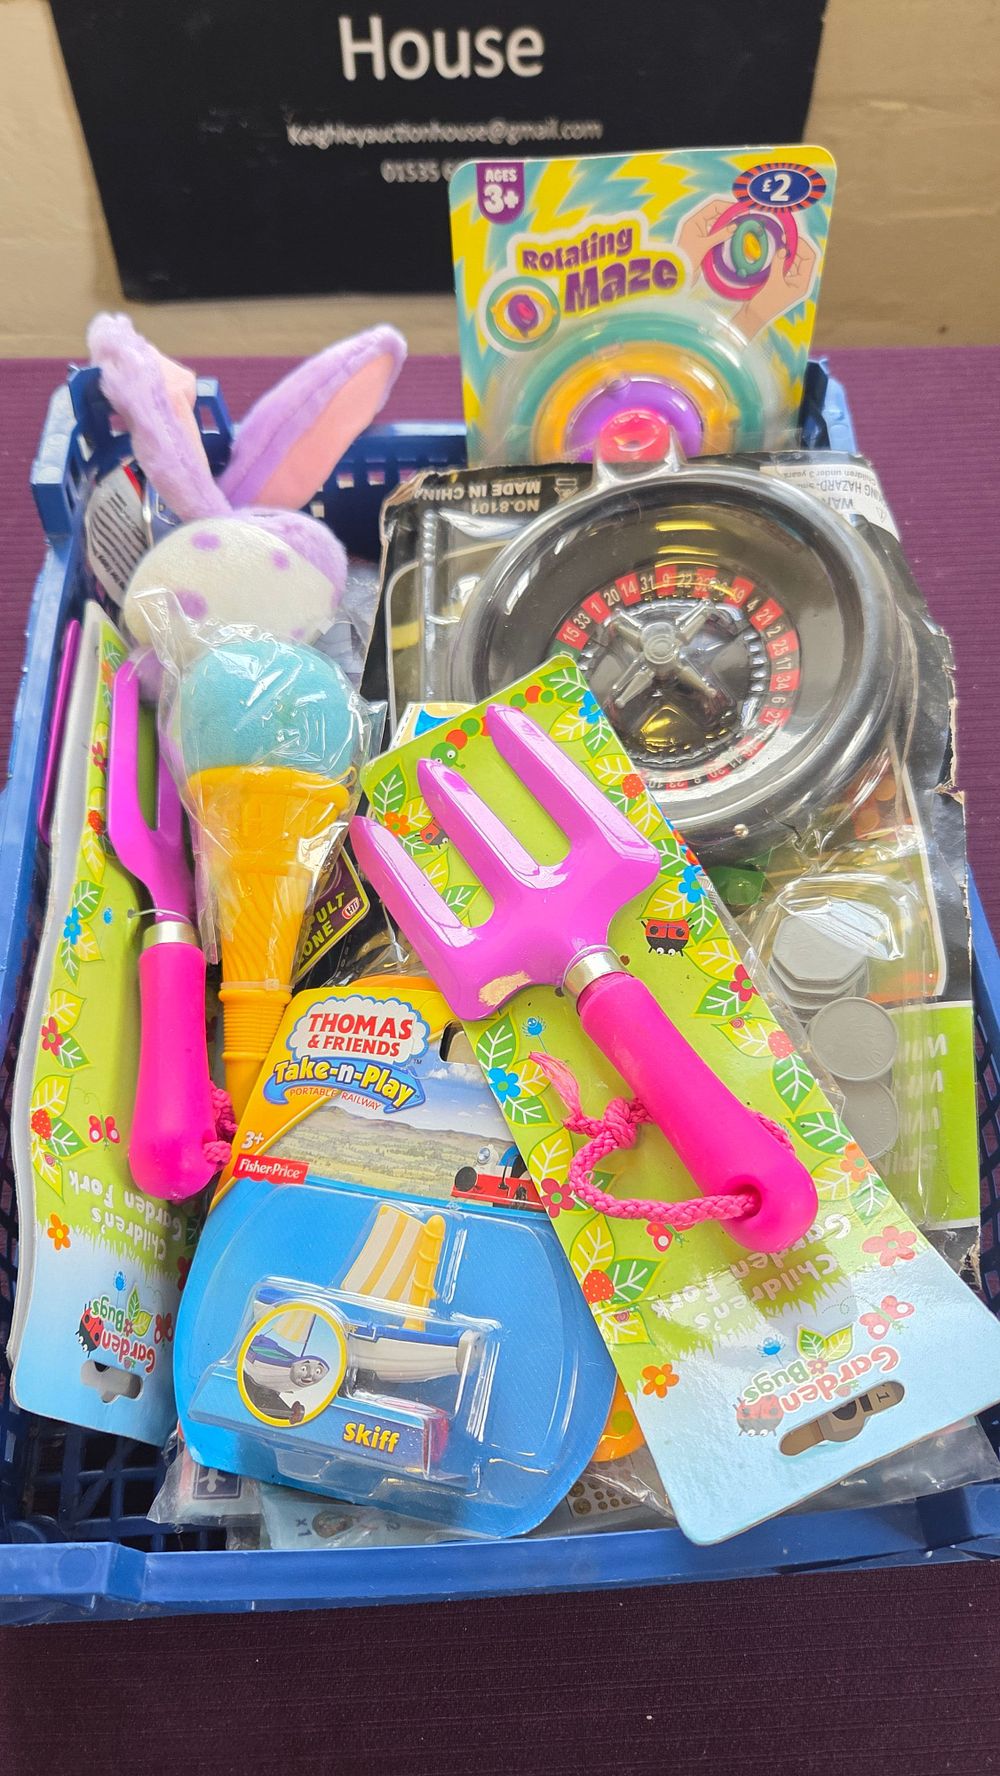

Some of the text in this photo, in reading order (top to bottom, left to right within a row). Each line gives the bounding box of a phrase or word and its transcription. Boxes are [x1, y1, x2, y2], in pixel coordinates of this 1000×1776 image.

[338, 14, 545, 81] House
[484, 168, 518, 183] AGES
[761, 173, 791, 202] £2
[483, 186, 519, 214] 3+
[521, 227, 633, 272] Rotating
[564, 258, 678, 313] Maze
[469, 485, 487, 498] IN
[492, 480, 541, 496] MADE
[603, 588, 621, 606] 20
[621, 580, 637, 597] 14
[591, 601, 602, 614] 1
[746, 599, 759, 613] 4
[755, 608, 775, 626] 21
[573, 612, 591, 630] 33
[766, 625, 781, 638] 2
[771, 639, 789, 657] 25
[775, 674, 791, 691] 34
[308, 1013, 414, 1040] THOMAS
[307, 1034, 401, 1058] & FRIENDS
[274, 1055, 417, 1109] Take-n-Play
[290, 1087, 382, 1111] PORTABLE RAILWAY
[240, 1130, 265, 1150] 3+
[238, 1157, 301, 1180] Fisher-Price
[68, 1170, 182, 1241] Garden Fork
[91, 1207, 167, 1261] Children's
[694, 1253, 838, 1332] Children's
[91, 1295, 125, 1333] Bugs
[101, 1331, 156, 1374] Garden
[742, 1359, 811, 1402] Bugs
[779, 1345, 899, 1412] Garden
[342, 1422, 401, 1455] Skiff
